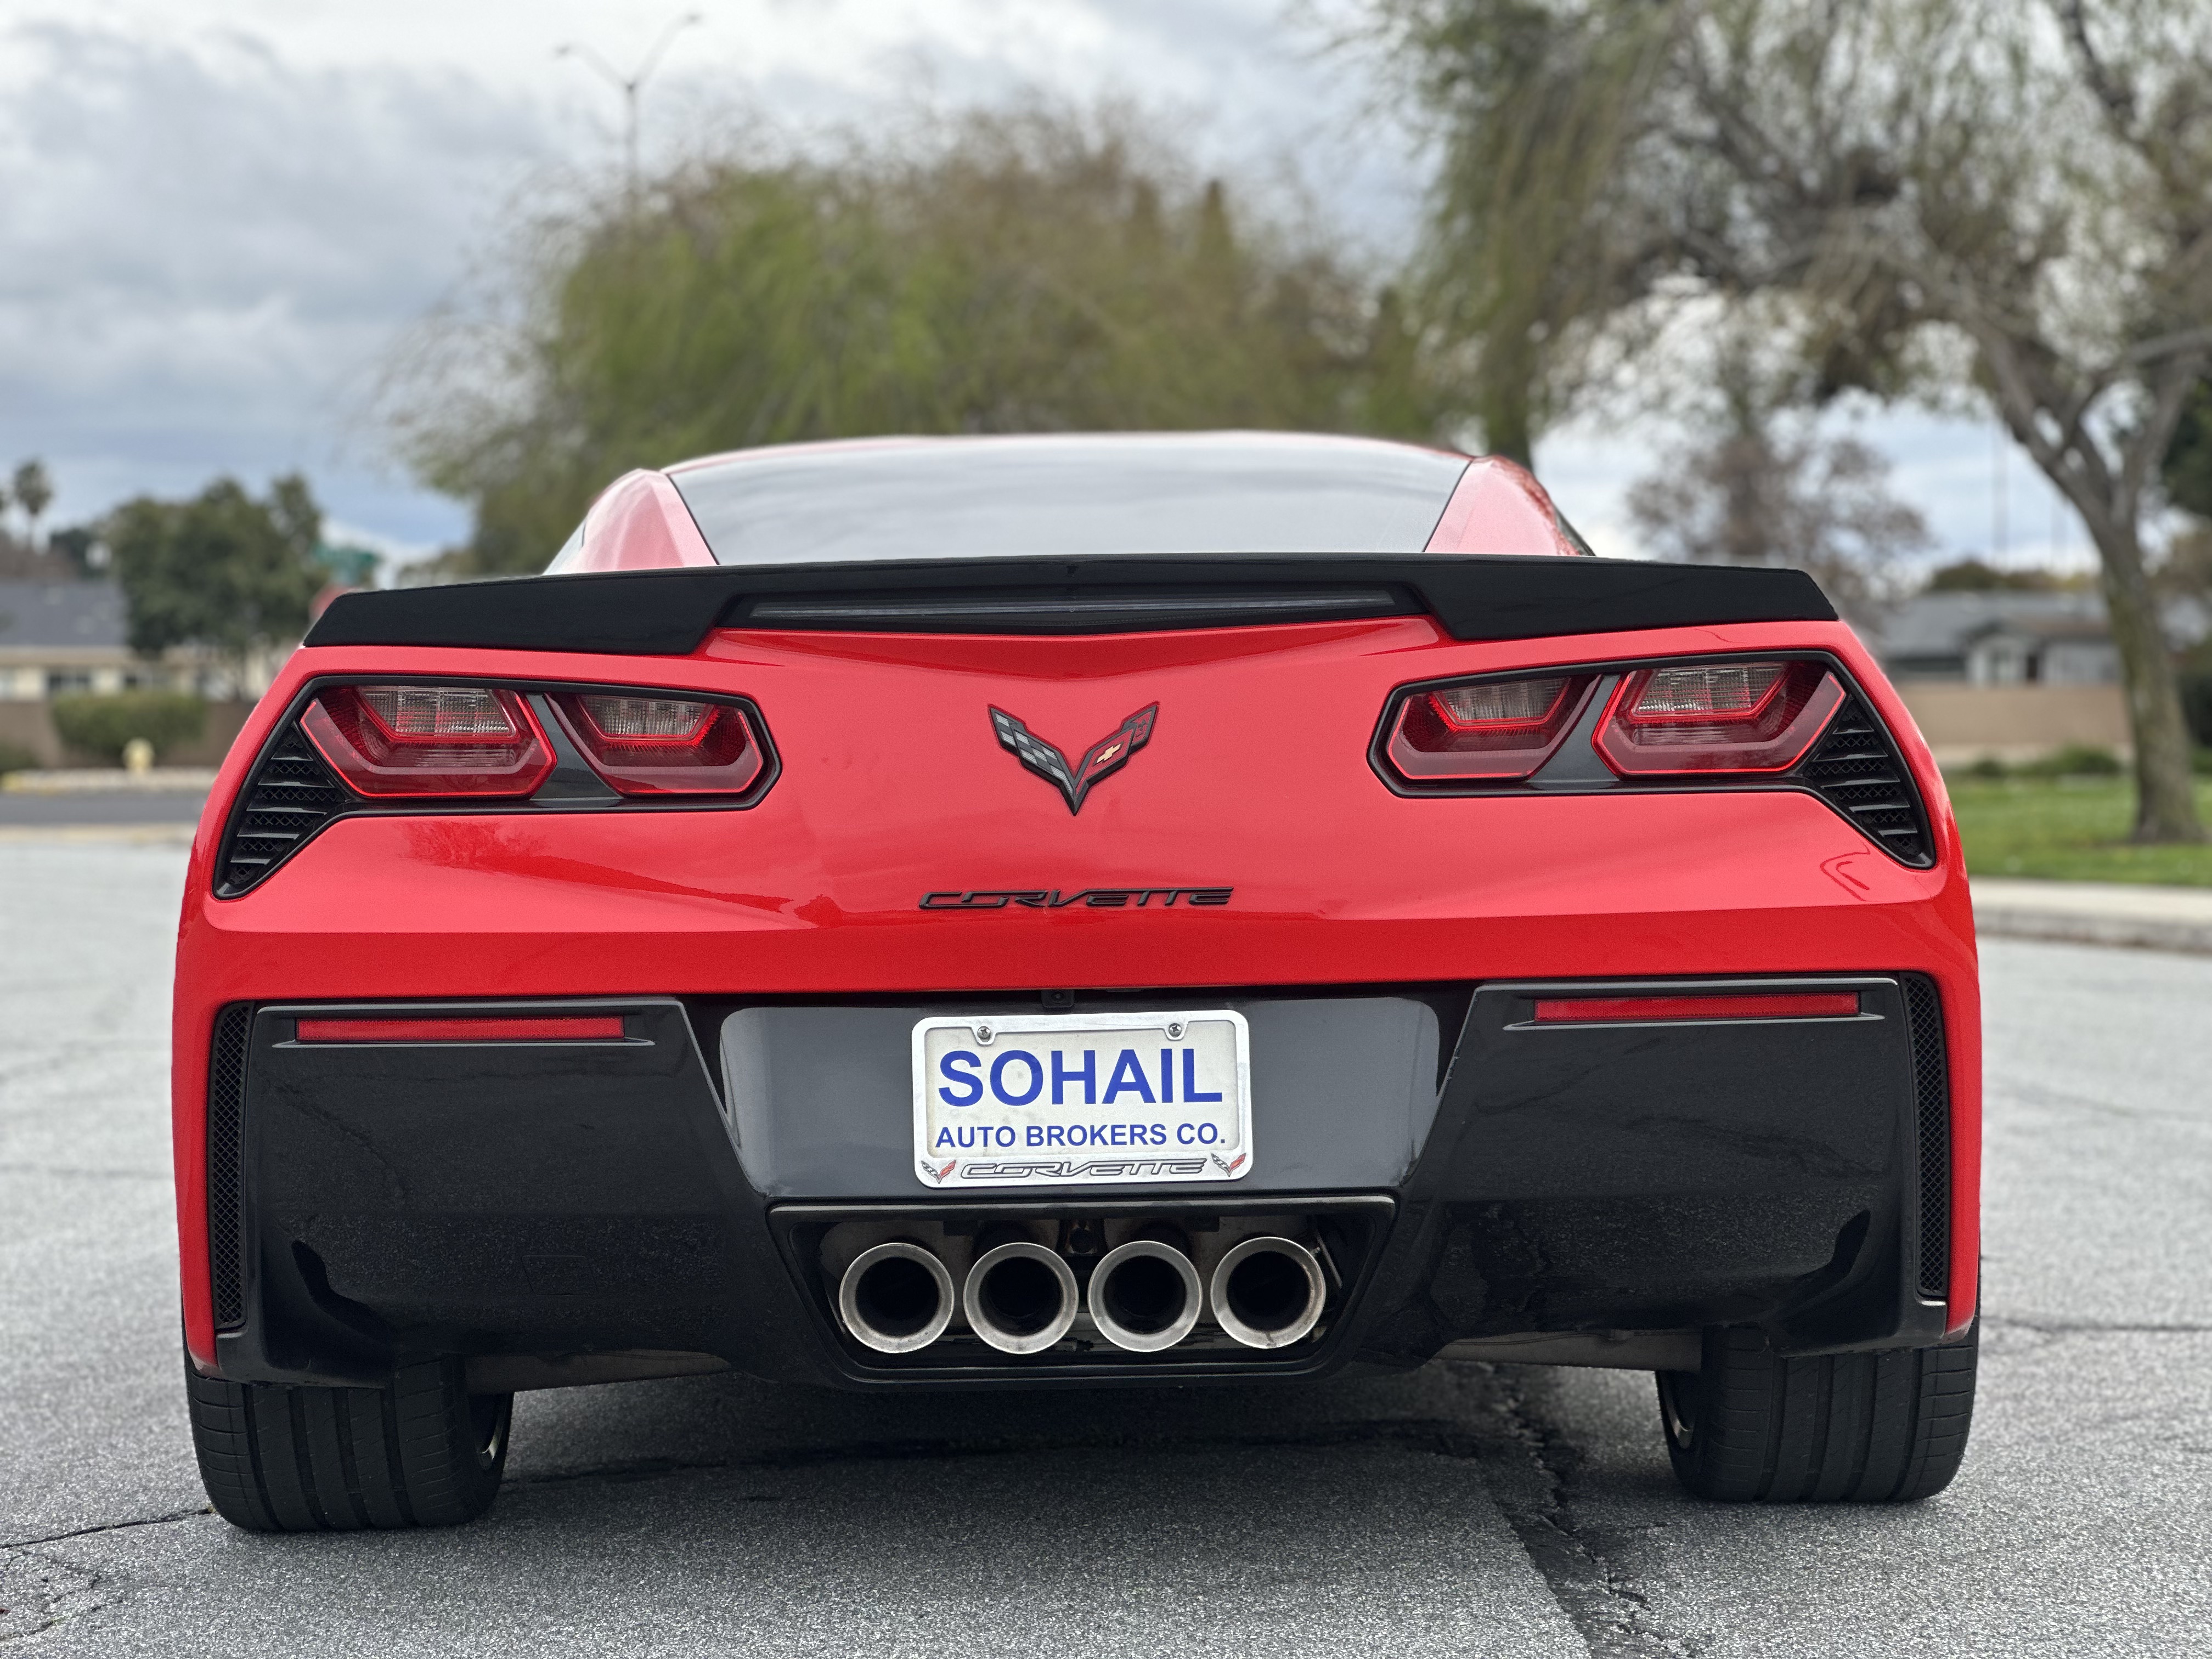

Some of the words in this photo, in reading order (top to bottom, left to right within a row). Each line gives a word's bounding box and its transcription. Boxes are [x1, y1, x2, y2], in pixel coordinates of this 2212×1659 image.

[919, 887, 1233, 910] CORVETTE
[938, 1048, 1223, 1107] SOHAIL
[935, 1126, 1016, 1148] AUTO
[1026, 1124, 1167, 1147] BROKERS
[1176, 1123, 1225, 1144] CO.
[960, 1158, 1207, 1180] CORVETTE
